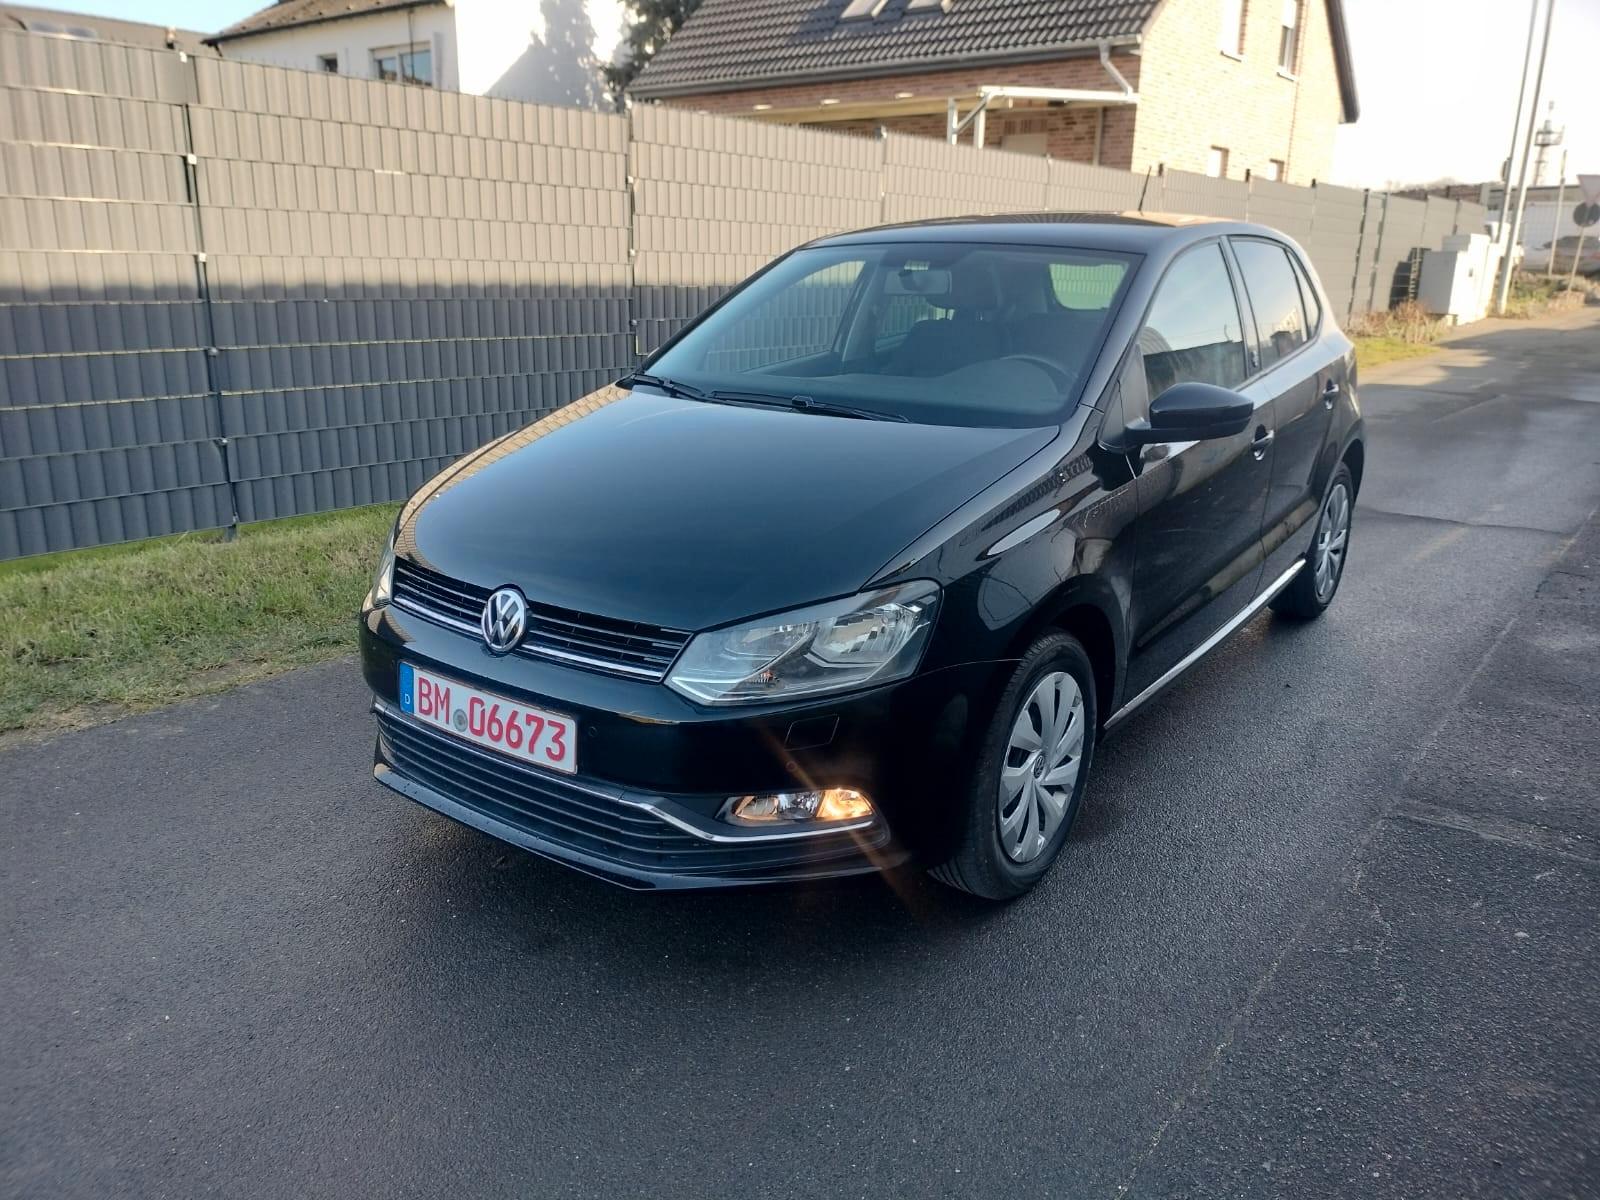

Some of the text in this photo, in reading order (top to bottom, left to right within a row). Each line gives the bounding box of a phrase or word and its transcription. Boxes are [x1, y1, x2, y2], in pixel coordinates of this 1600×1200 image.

[404, 677, 566, 762] D BM 06673
